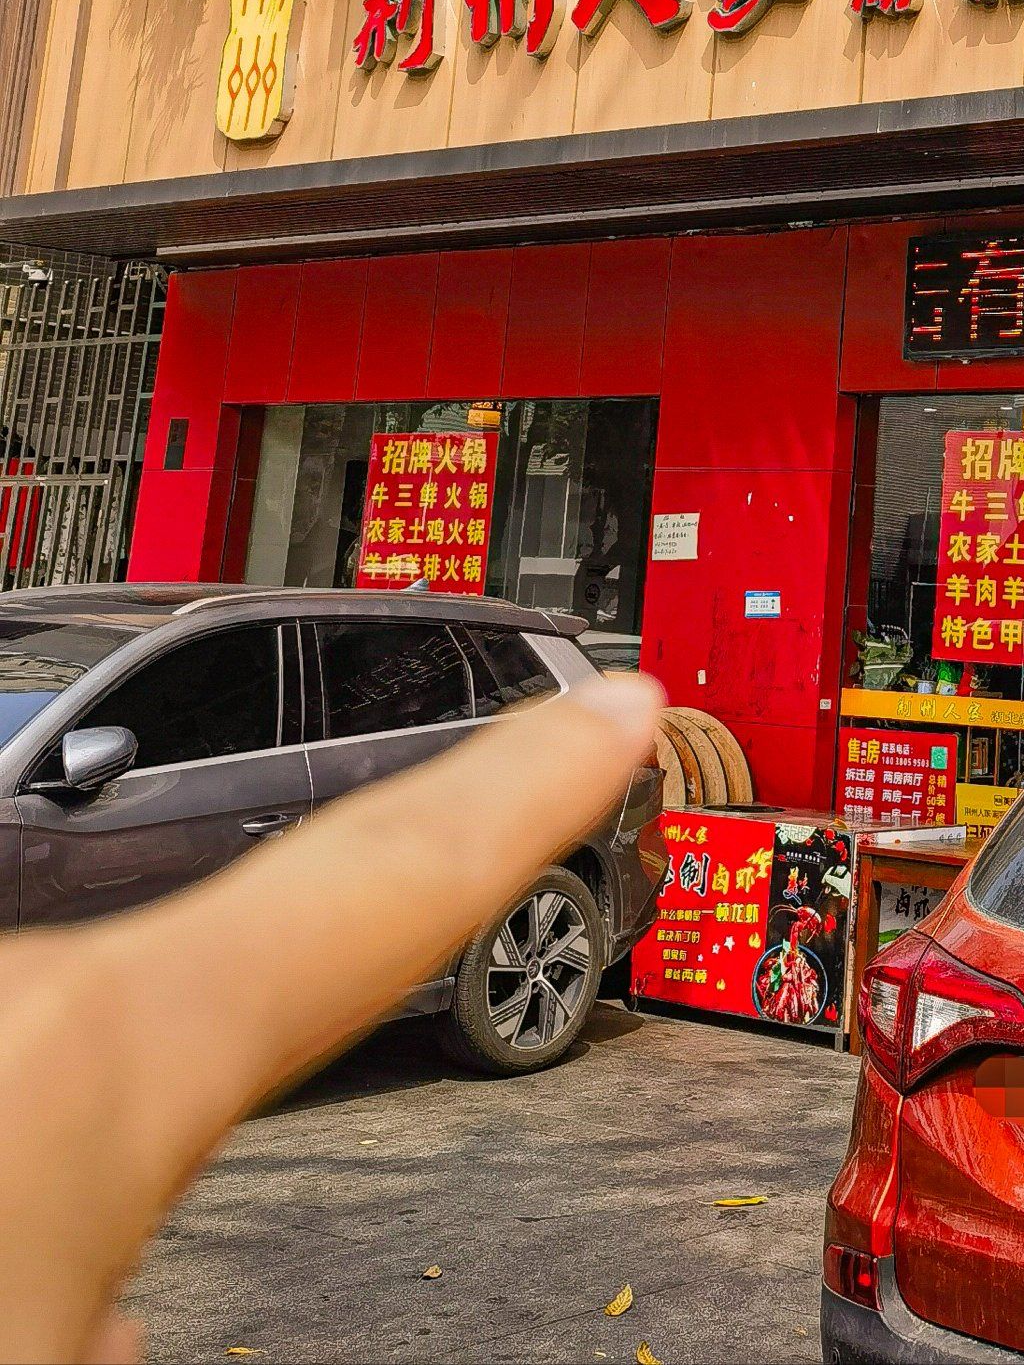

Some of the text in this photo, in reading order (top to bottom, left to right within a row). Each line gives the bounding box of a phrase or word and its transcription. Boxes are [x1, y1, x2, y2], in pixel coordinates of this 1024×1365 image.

[381, 437, 487, 475] 招牌火锅
[371, 482, 488, 509] 牛三鲜火锅
[367, 517, 486, 545] 农家土鸡火锅
[363, 552, 482, 583] 羊肉羊排火锅
[845, 767, 923, 786] 拆迁房 两房两厅
[844, 785, 875, 801] 农民房
[664, 825, 709, 845] 州人家
